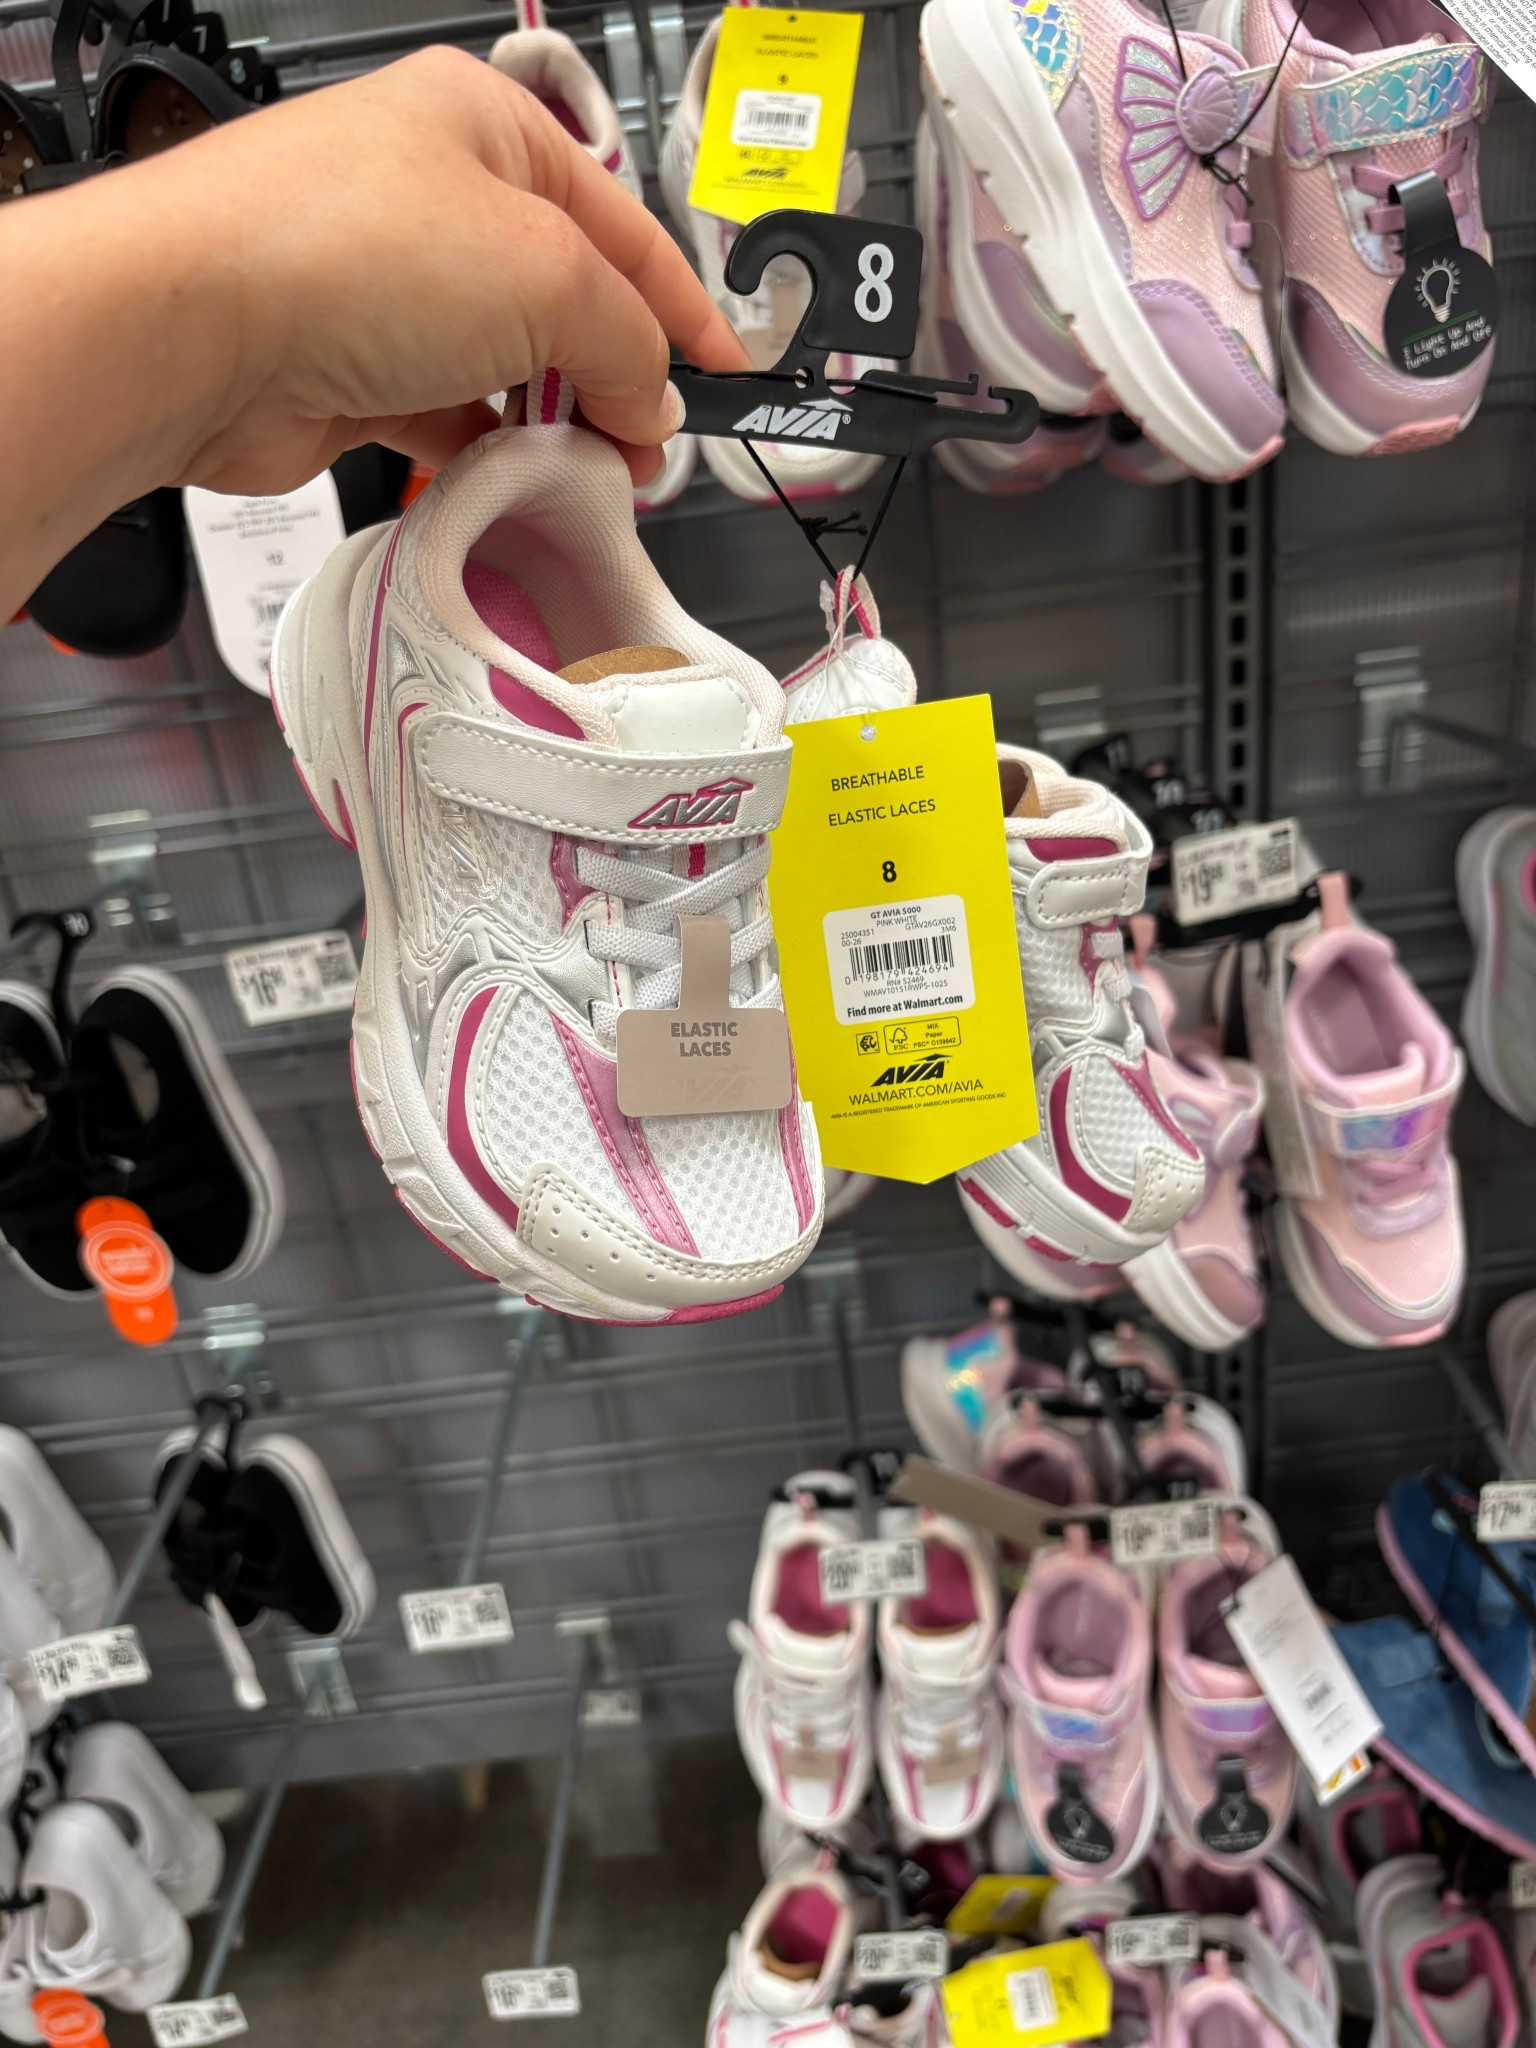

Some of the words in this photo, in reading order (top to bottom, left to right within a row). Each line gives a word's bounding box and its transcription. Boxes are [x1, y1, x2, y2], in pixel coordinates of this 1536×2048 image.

[854, 242, 895, 323] 8
[831, 765, 925, 792] BREATHABLE
[628, 778, 754, 830] AVIA
[828, 806, 887, 827] ELASTIC
[890, 799, 936, 817] LACES
[881, 860, 897, 883] 8
[870, 911, 881, 920] GT
[882, 908, 901, 918] AVIA
[902, 905, 922, 915] 5000
[876, 919, 893, 928] PINK
[893, 914, 917, 925] WHITE
[840, 929, 875, 940] 25004351
[904, 916, 956, 931] GTAV26GX002
[841, 938, 862, 947] 00-26
[940, 925, 957, 934] 3M6
[844, 976, 851, 985] 0
[859, 969, 900, 983] 198179
[907, 962, 949, 976] 424694
[902, 975, 925, 985] 52469
[847, 1005, 867, 1018] Find
[868, 1003, 892, 1015] more
[892, 1002, 903, 1012] at
[903, 994, 964, 1011] Walmart.com
[671, 1021, 738, 1038] ELASTIC
[925, 1031, 943, 1039] Paper
[926, 1022, 939, 1030] MIX
[680, 1041, 732, 1057] LACES
[848, 1078, 984, 1106] WALMART.COM/AVIA
[853, 1107, 883, 1116] REGISTERED
[883, 1103, 914, 1113] TRADEMARK
[922, 1099, 950, 1108] AMERICAN
[950, 1095, 976, 1104] SPORTING
[976, 1093, 996, 1101] GOODS
